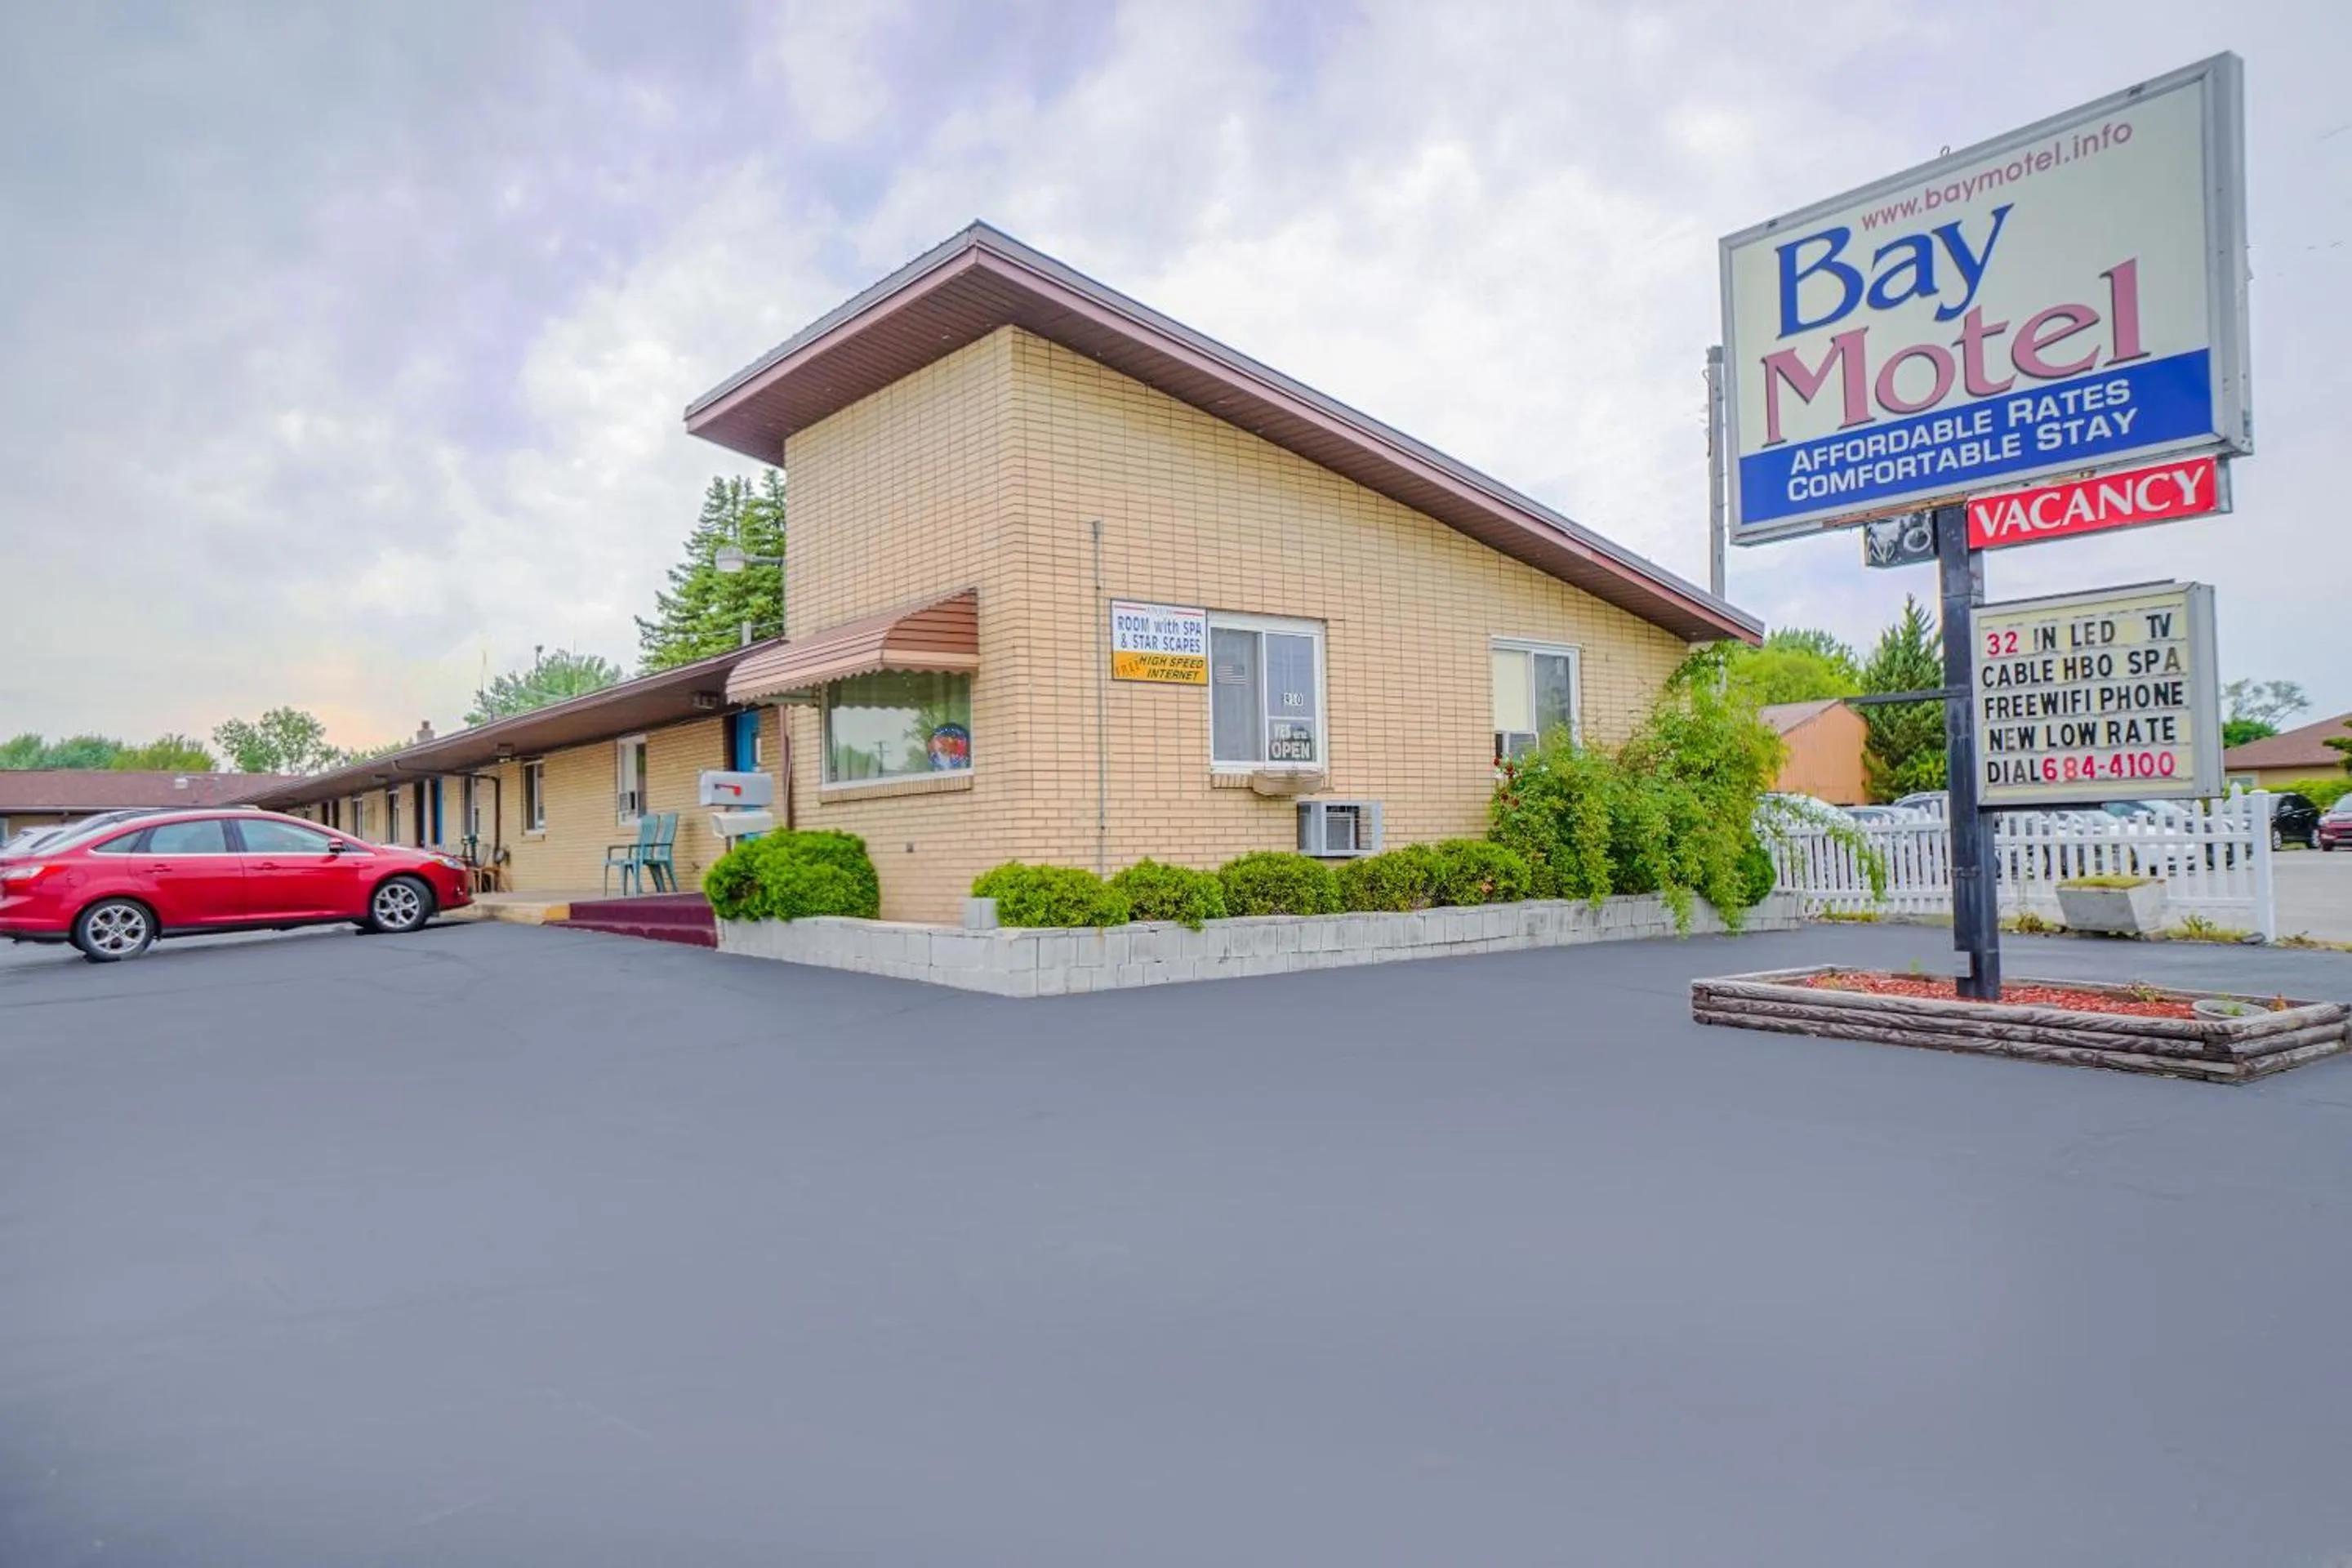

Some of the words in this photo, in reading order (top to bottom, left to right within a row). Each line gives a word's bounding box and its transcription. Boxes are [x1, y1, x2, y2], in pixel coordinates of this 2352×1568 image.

[1861, 122, 2133, 231] www.baymotel.info
[1775, 203, 2015, 340] Bay
[1761, 256, 2152, 448] Motel
[1790, 409, 1993, 476] AFFORDABLE
[2008, 378, 2132, 429] RATES
[1788, 432, 2021, 502] COMFORTABLE
[2036, 407, 2139, 451] STAY
[1975, 466, 2207, 538] VACANCY
[1117, 616, 1149, 633] ROOM
[1154, 618, 1179, 635] with
[1183, 621, 1203, 636] SPA
[1133, 634, 1158, 650] STAR
[1163, 635, 1201, 653] SCAPES
[1986, 630, 2019, 655] 32
[2034, 626, 2056, 651] IN
[2070, 620, 2116, 647] LED
[2145, 612, 2172, 639] TV
[1139, 655, 1167, 666] HIGH
[1169, 657, 1205, 669] SPEED
[1147, 668, 1200, 680] INTERNET
[1982, 659, 2054, 688] CABLE
[2063, 653, 2113, 680] HBO
[2127, 647, 2181, 675] SPA
[2100, 681, 2184, 711] PHONE
[1272, 740, 1310, 759] OPEN
[1989, 725, 2035, 751] NEW
[2047, 721, 2097, 747] LOW
[2107, 716, 2176, 744] RATE
